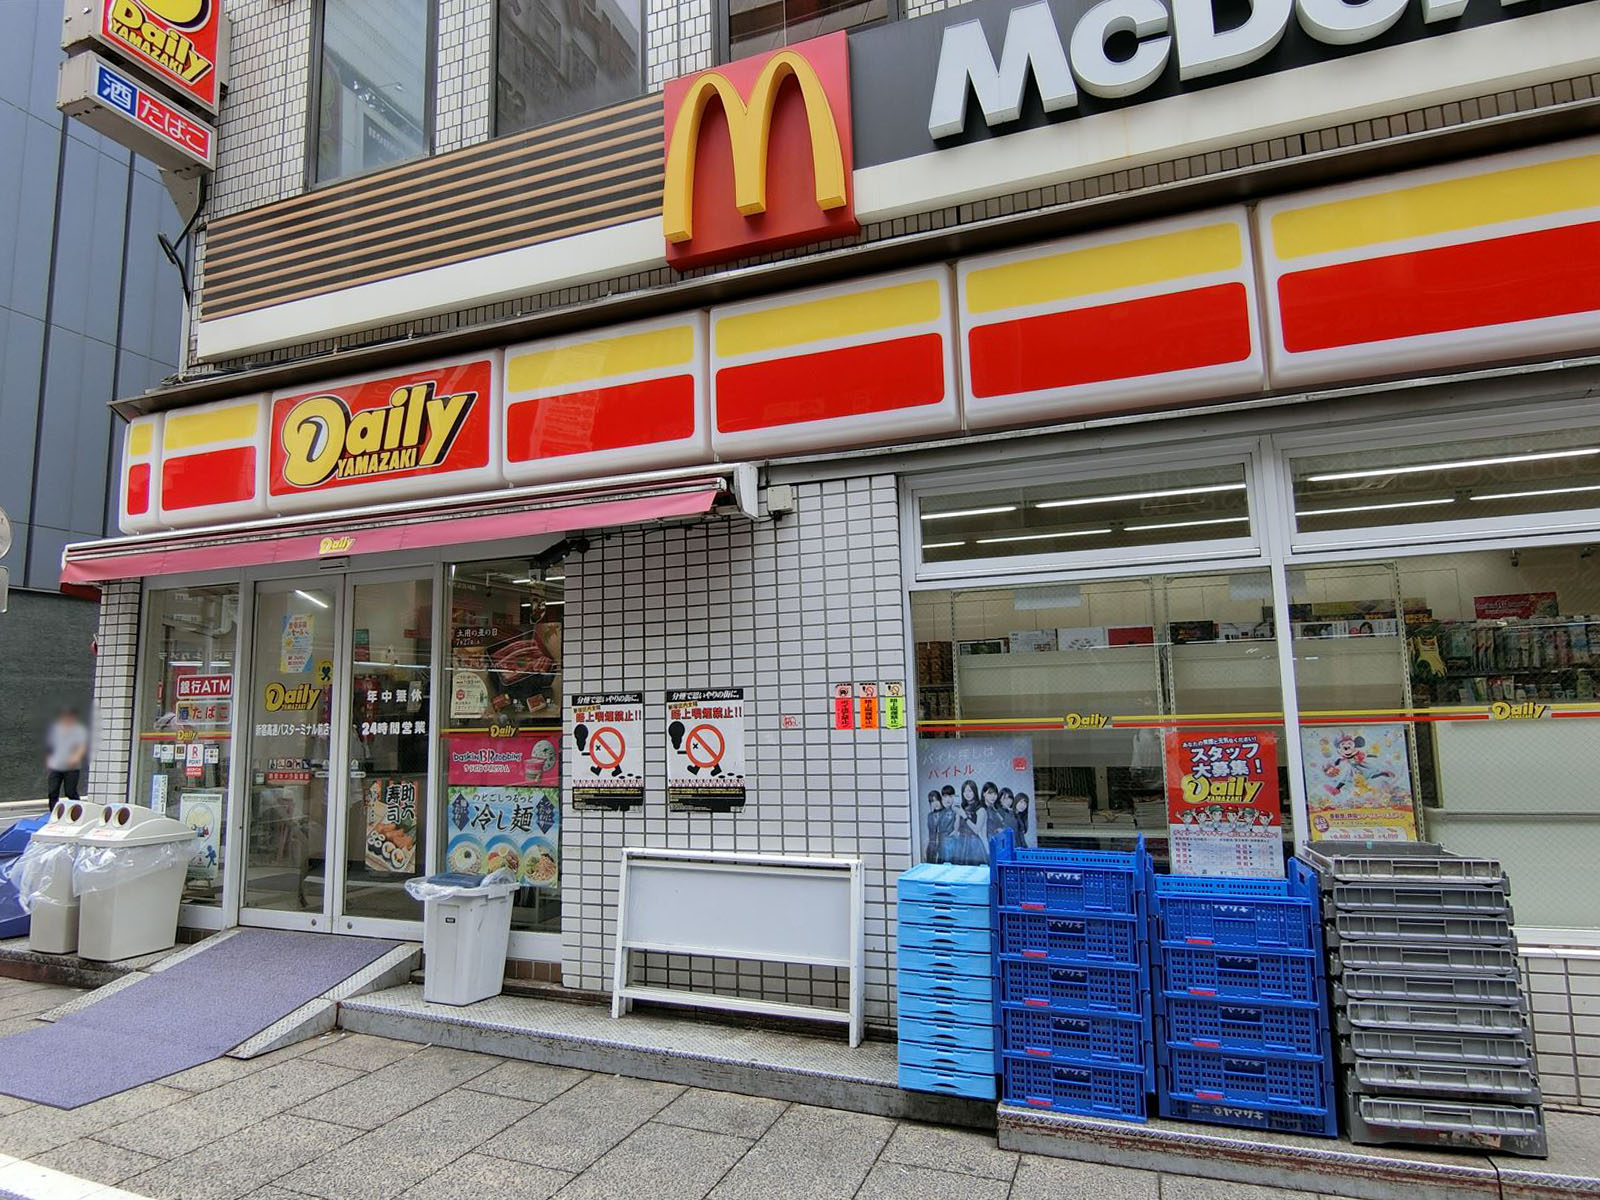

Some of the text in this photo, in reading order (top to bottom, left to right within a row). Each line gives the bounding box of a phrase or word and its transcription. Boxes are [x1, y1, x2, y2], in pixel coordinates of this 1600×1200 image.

[111, 0, 212, 83] Daily
[111, 18, 183, 75] YAMAZAKI
[102, 72, 206, 153] 酒 たばこ
[281, 381, 476, 487] Daily
[336, 447, 418, 479] YAMAZAKI
[318, 536, 355, 555] Daily
[180, 679, 231, 694] 銀行ATM
[367, 689, 423, 703] 年中無休
[264, 682, 322, 712] Daily
[191, 705, 228, 720] たばこ
[1491, 701, 1548, 720] Daily
[361, 721, 426, 736] 24時間営業
[1065, 712, 1110, 730] Daily
[176, 729, 197, 741] Daily
[489, 724, 517, 738] Daily
[1191, 743, 1259, 762] スタッフ
[1181, 775, 1263, 803] Daily
[386, 783, 416, 824] 助六 寿司
[470, 803, 534, 833] 冷し麺
[1223, 1107, 1265, 1120] ヤマザキ
